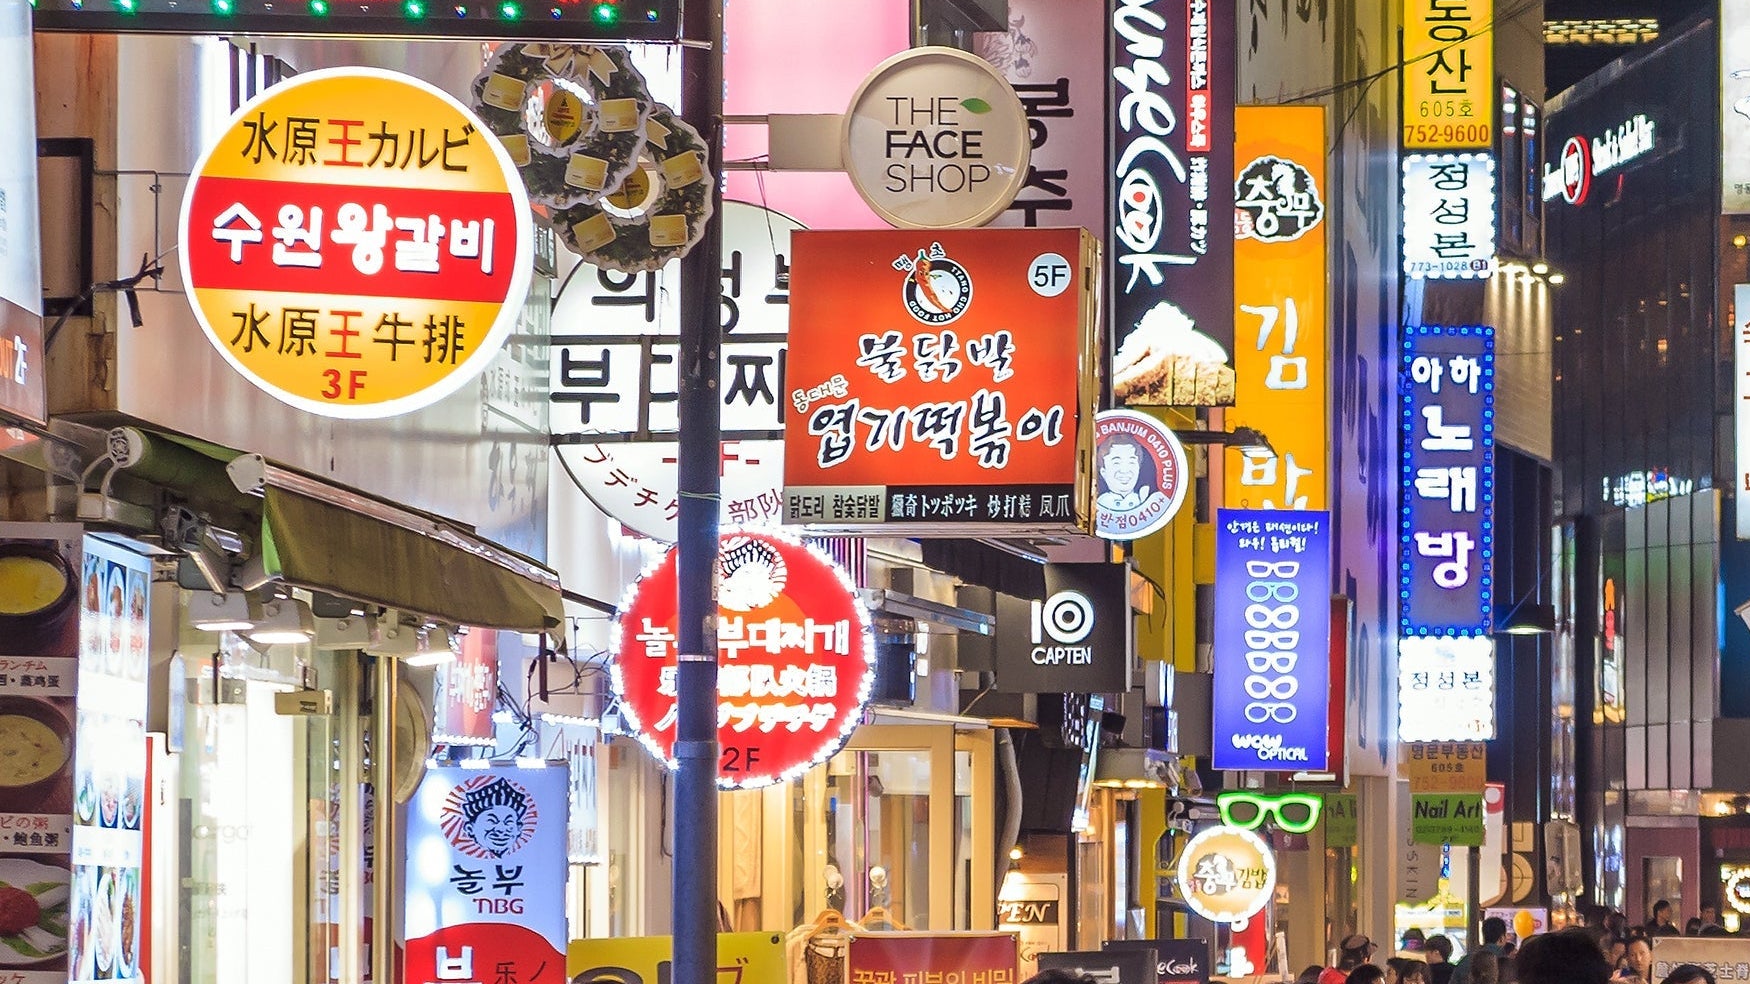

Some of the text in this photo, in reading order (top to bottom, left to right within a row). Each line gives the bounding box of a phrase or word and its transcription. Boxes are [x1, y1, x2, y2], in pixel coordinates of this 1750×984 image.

[886, 97, 959, 125] THE
[1418, 100, 1475, 119] 605호
[241, 111, 474, 173] 水原王カルビ
[885, 130, 983, 160] FACE
[1404, 123, 1490, 144] 752-9600
[885, 164, 991, 193] SHOP
[1428, 162, 1476, 260] 정성본
[212, 203, 497, 277] 수원왕갈비
[1033, 265, 1068, 288] 5F
[231, 303, 467, 366] 水原王牛排
[856, 331, 1016, 383] 불닭발
[321, 368, 368, 401] 3F
[1411, 355, 1482, 394] 아하
[810, 391, 1064, 468] 엽기떡볶이
[1101, 421, 1173, 491] BANJUM 0410 PLUS
[789, 495, 881, 519] 닭도리 참숯닭발
[1414, 406, 1477, 589] 노래방
[1030, 646, 1092, 666] CAPTEN
[1411, 671, 1485, 690] 정성본
[1232, 734, 1282, 750] WOW
[1257, 746, 1308, 761] OPTICAL
[1411, 744, 1484, 760] 명문부동산
[722, 746, 760, 772] 2F
[1414, 799, 1482, 820] Nail Art
[449, 864, 525, 895] 놀부
